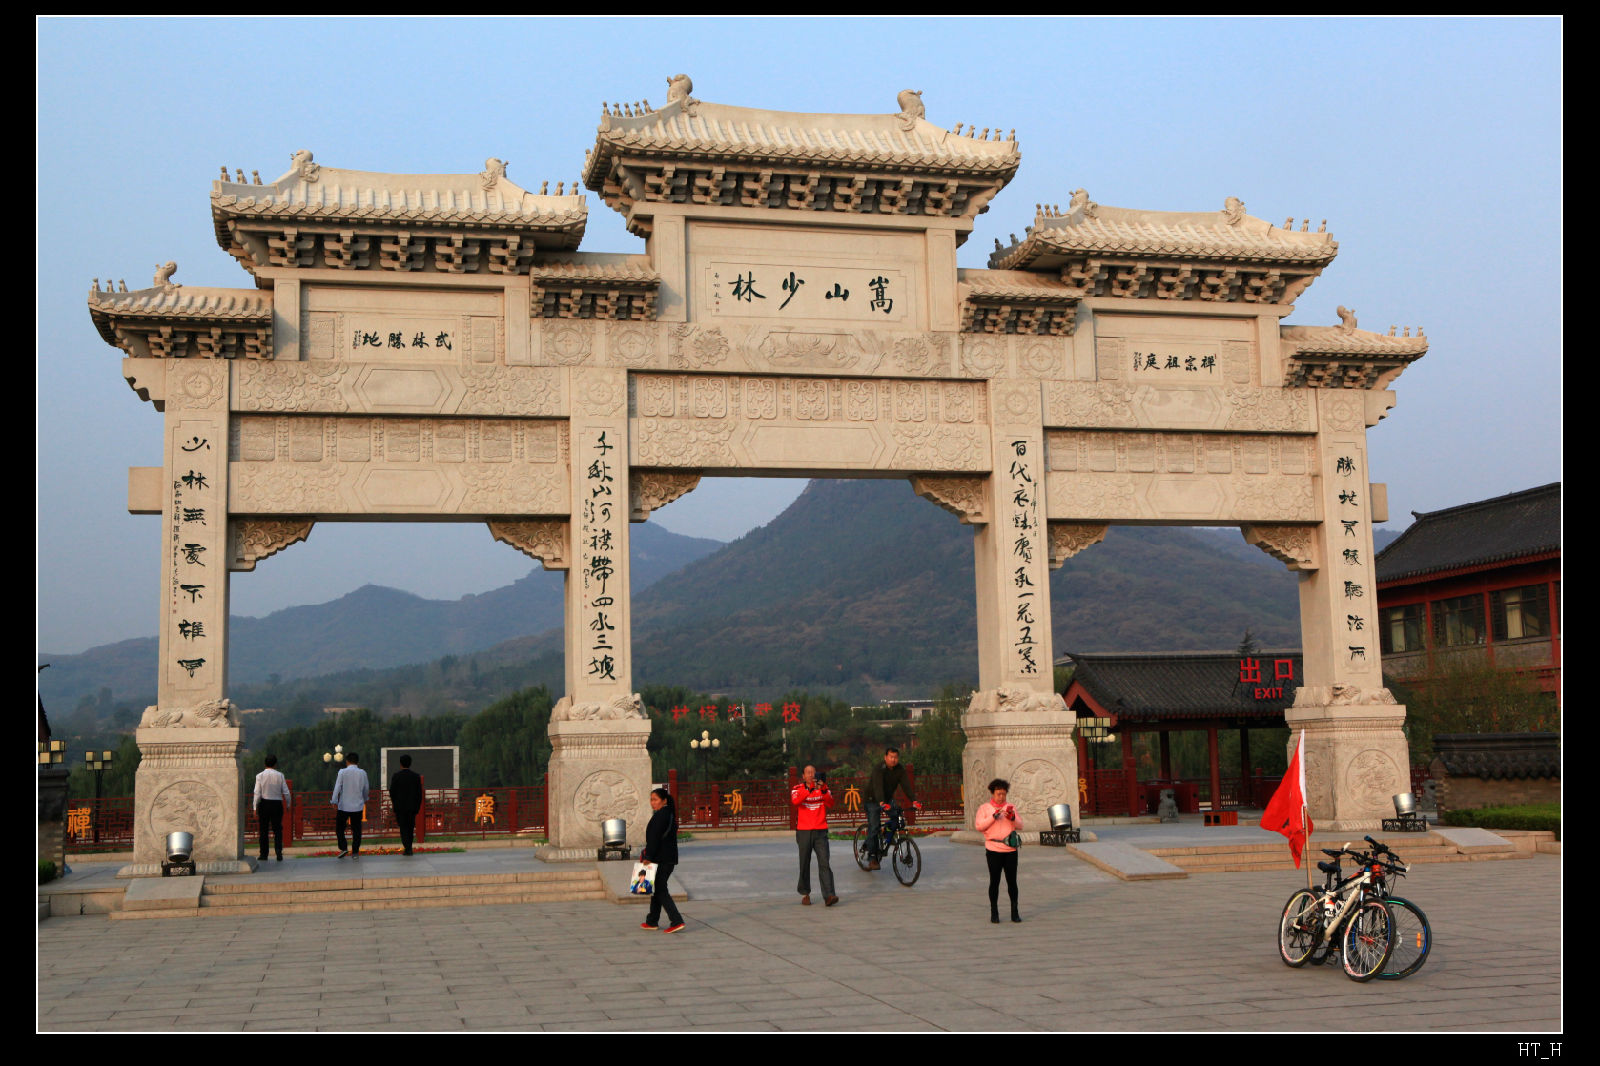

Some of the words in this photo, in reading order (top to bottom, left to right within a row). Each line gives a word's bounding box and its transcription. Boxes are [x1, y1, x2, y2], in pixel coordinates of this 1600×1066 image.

[728, 270, 894, 315] 嵩山少林
[1240, 657, 1294, 683] 出口
[1254, 687, 1283, 699] EXIT
